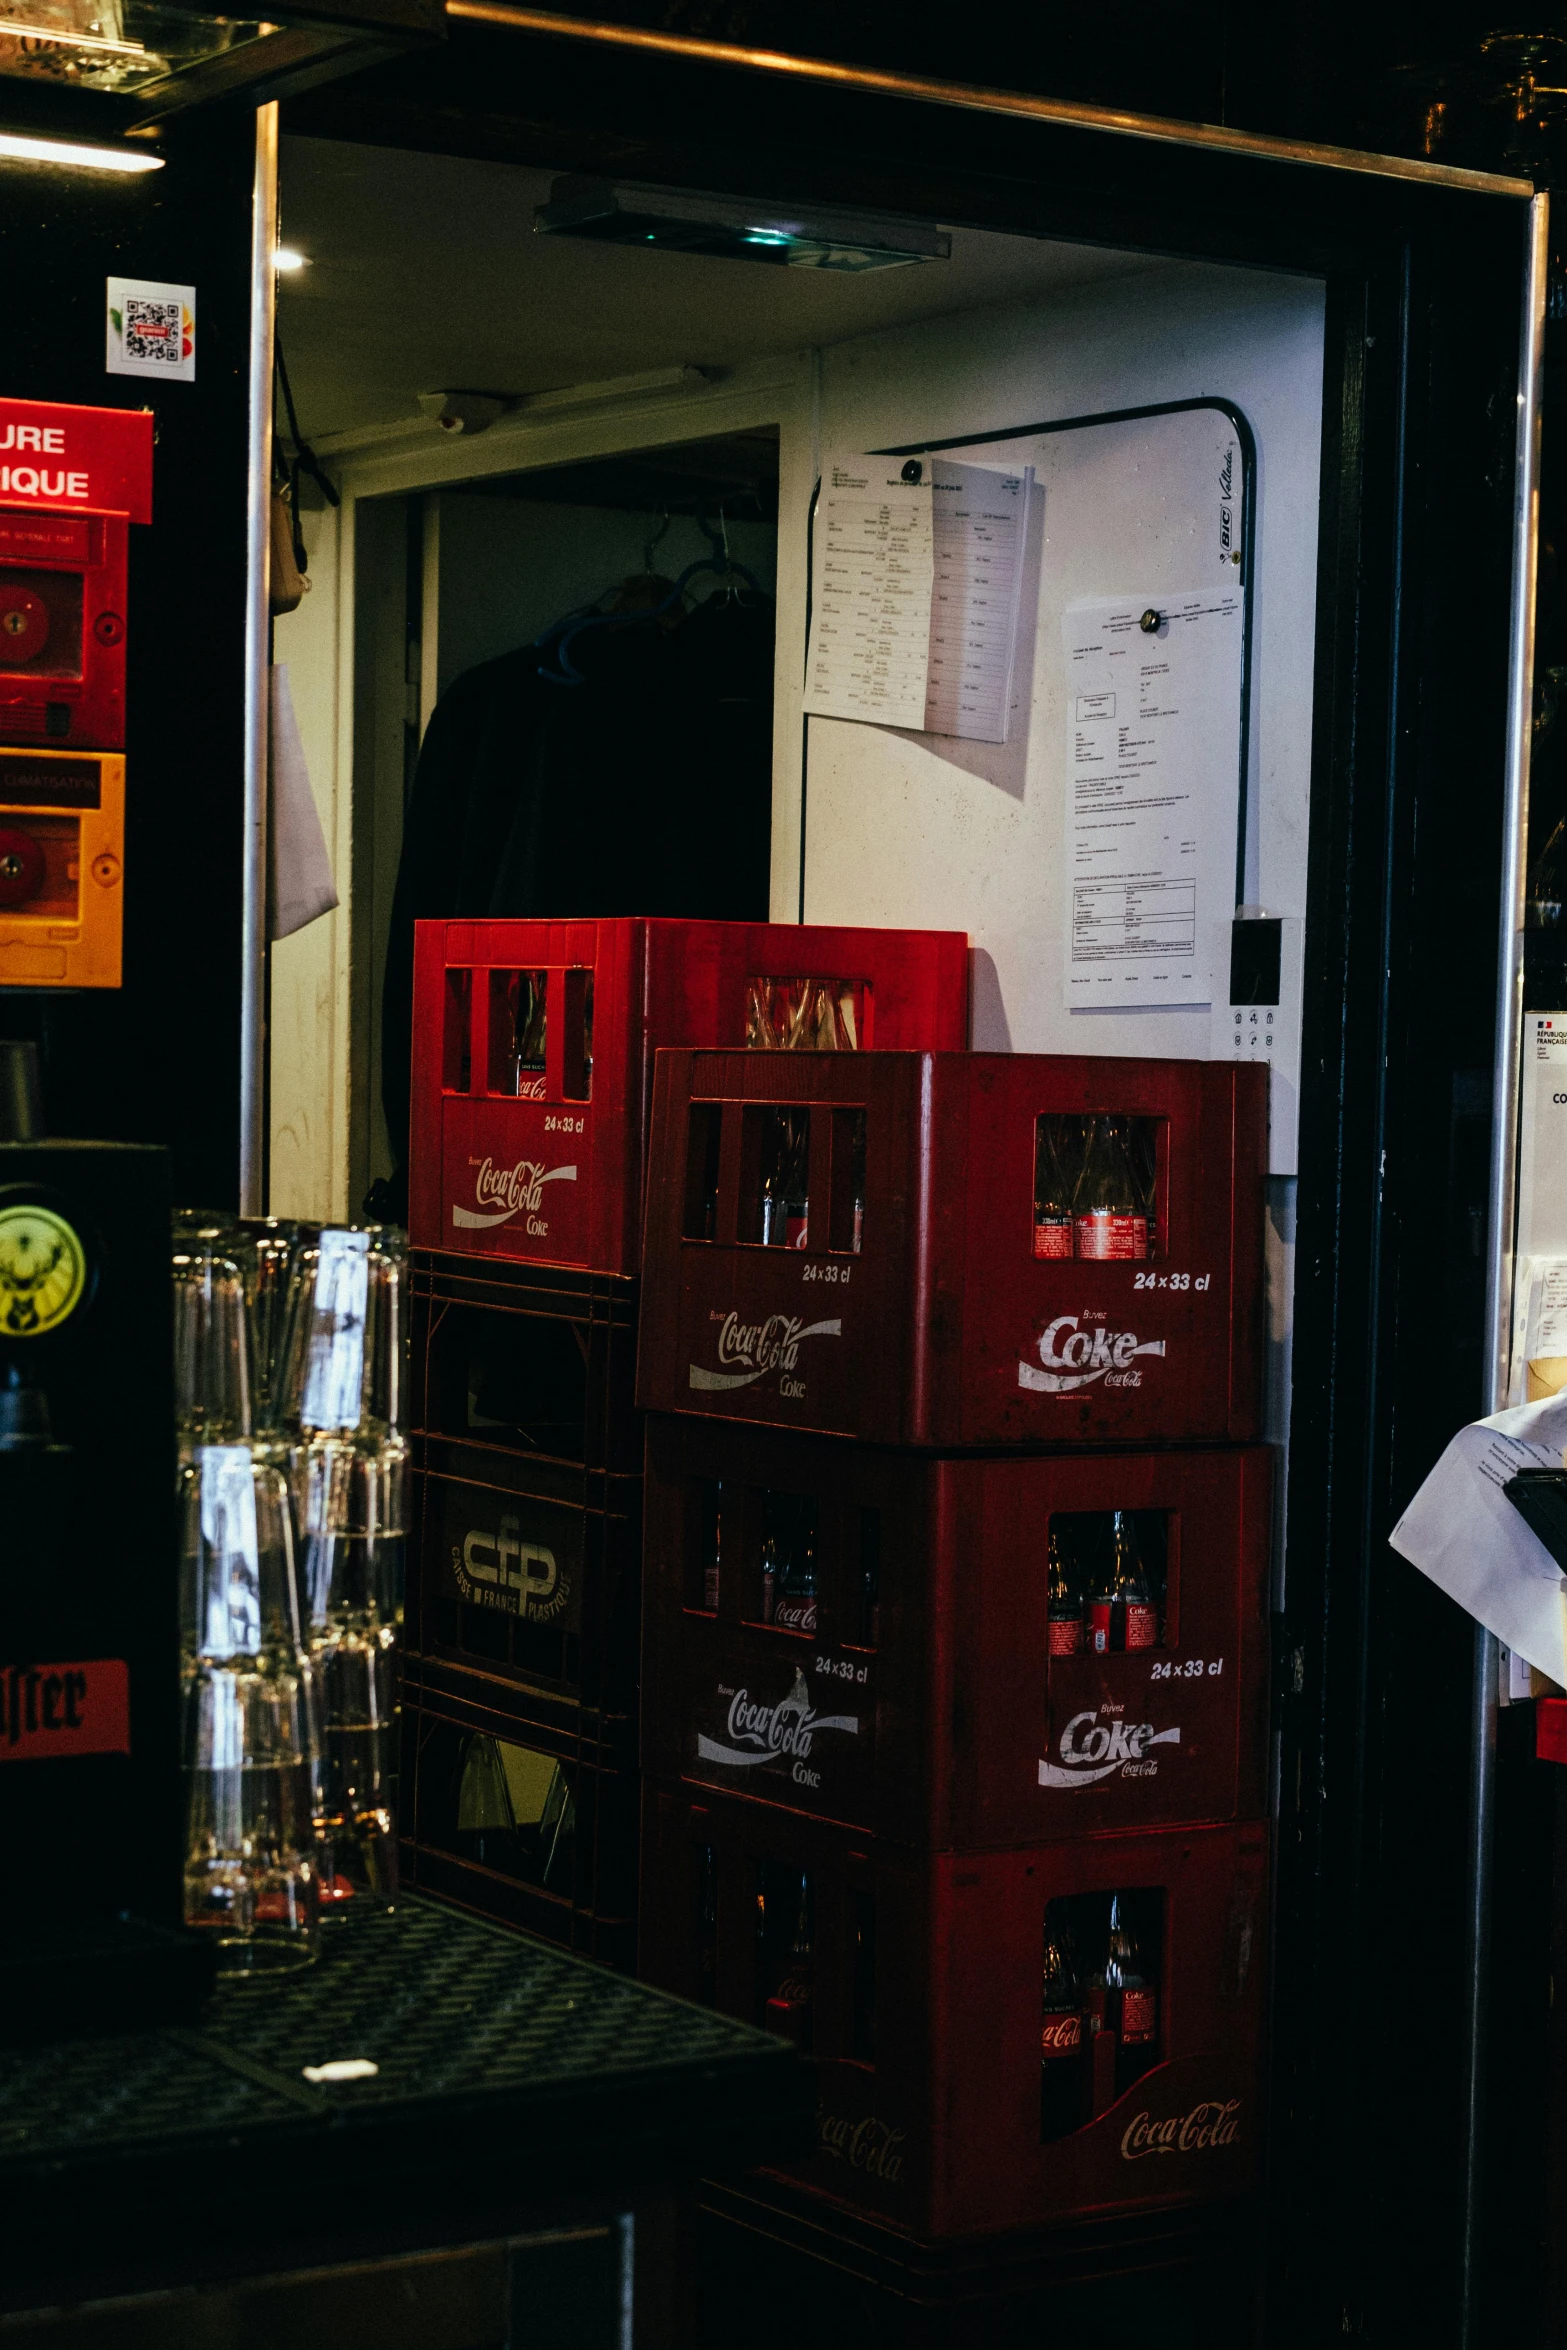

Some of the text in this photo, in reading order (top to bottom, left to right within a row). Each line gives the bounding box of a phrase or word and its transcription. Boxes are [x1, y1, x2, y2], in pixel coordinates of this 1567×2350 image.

[0, 466, 89, 498] IQUE
[1219, 448, 1233, 549] BIC Velleda
[475, 1157, 546, 1211] Coca-Cola
[526, 1214, 549, 1236] Coke
[1194, 1273, 1211, 1291] cl
[1082, 1309, 1108, 1320] Buvez
[718, 1311, 805, 1371] Coca-Cola
[1039, 1315, 1138, 1369] Coke
[779, 1374, 806, 1399] Coke
[1104, 1370, 1143, 1387] Coca-Cola
[1208, 1657, 1224, 1676] cl
[1101, 1704, 1125, 1714] Buvez
[727, 1688, 818, 1759] Coca-Cola
[1059, 1711, 1154, 1764] Coke
[792, 1761, 821, 1788] Coke
[1121, 1760, 1159, 1778] Coca-Cola
[1125, 1991, 1145, 2000] Coke
[1120, 2098, 1244, 2160] Coca-Cola
